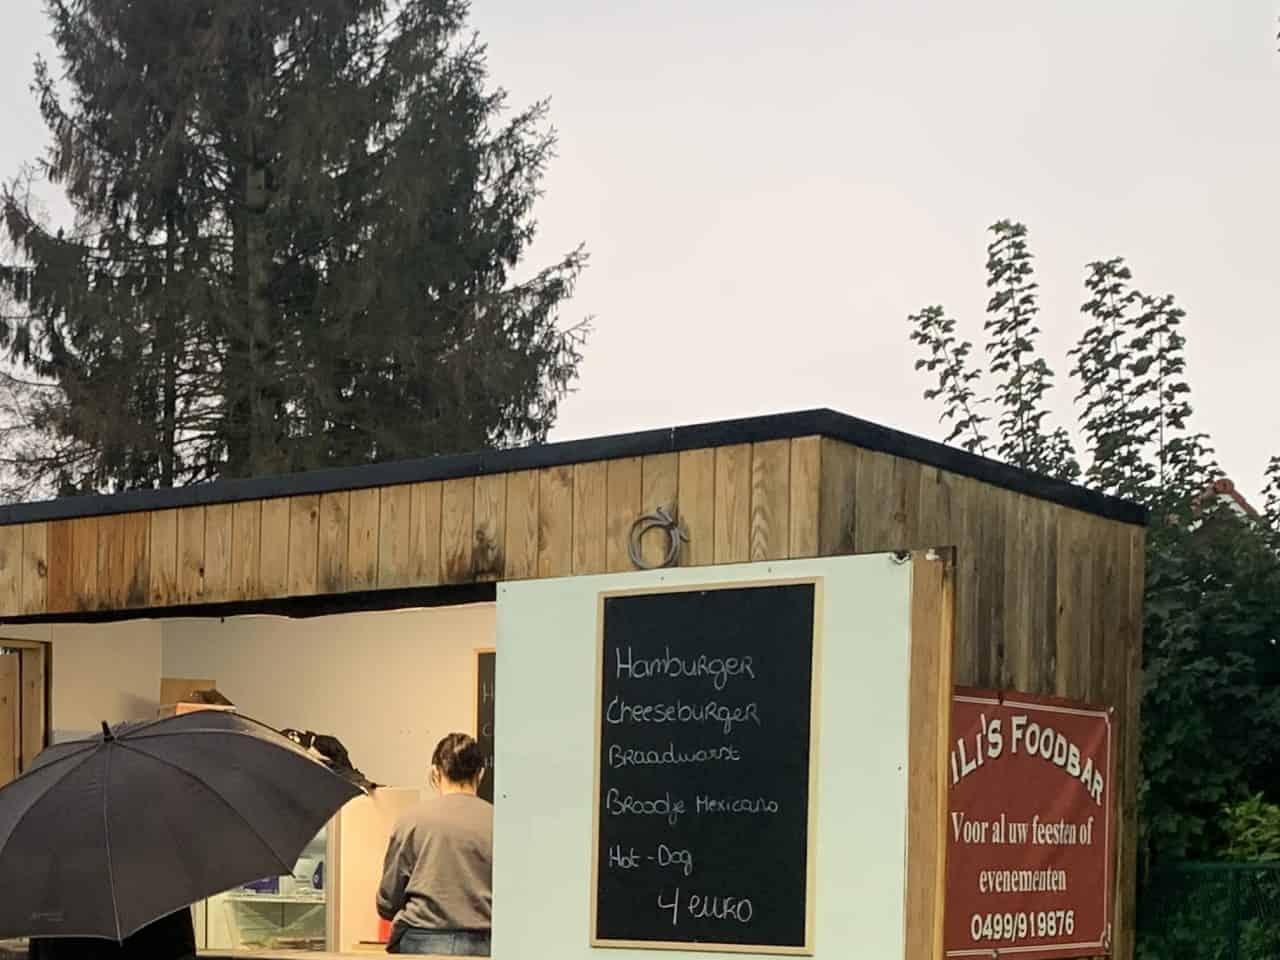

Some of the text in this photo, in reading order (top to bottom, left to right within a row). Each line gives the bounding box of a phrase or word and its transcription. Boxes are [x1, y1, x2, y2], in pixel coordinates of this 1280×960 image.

[615, 645, 755, 690] Hamburger
[606, 696, 761, 734] Cheeseburger
[951, 713, 1104, 806] ILI'S FOODBAR
[606, 787, 778, 824] Broodje Mexicano
[951, 811, 1094, 845] Voor al uw feesten of
[979, 868, 1067, 893] evenementen
[657, 887, 753, 925] 4 euro
[970, 910, 1074, 942] 0499/919876
